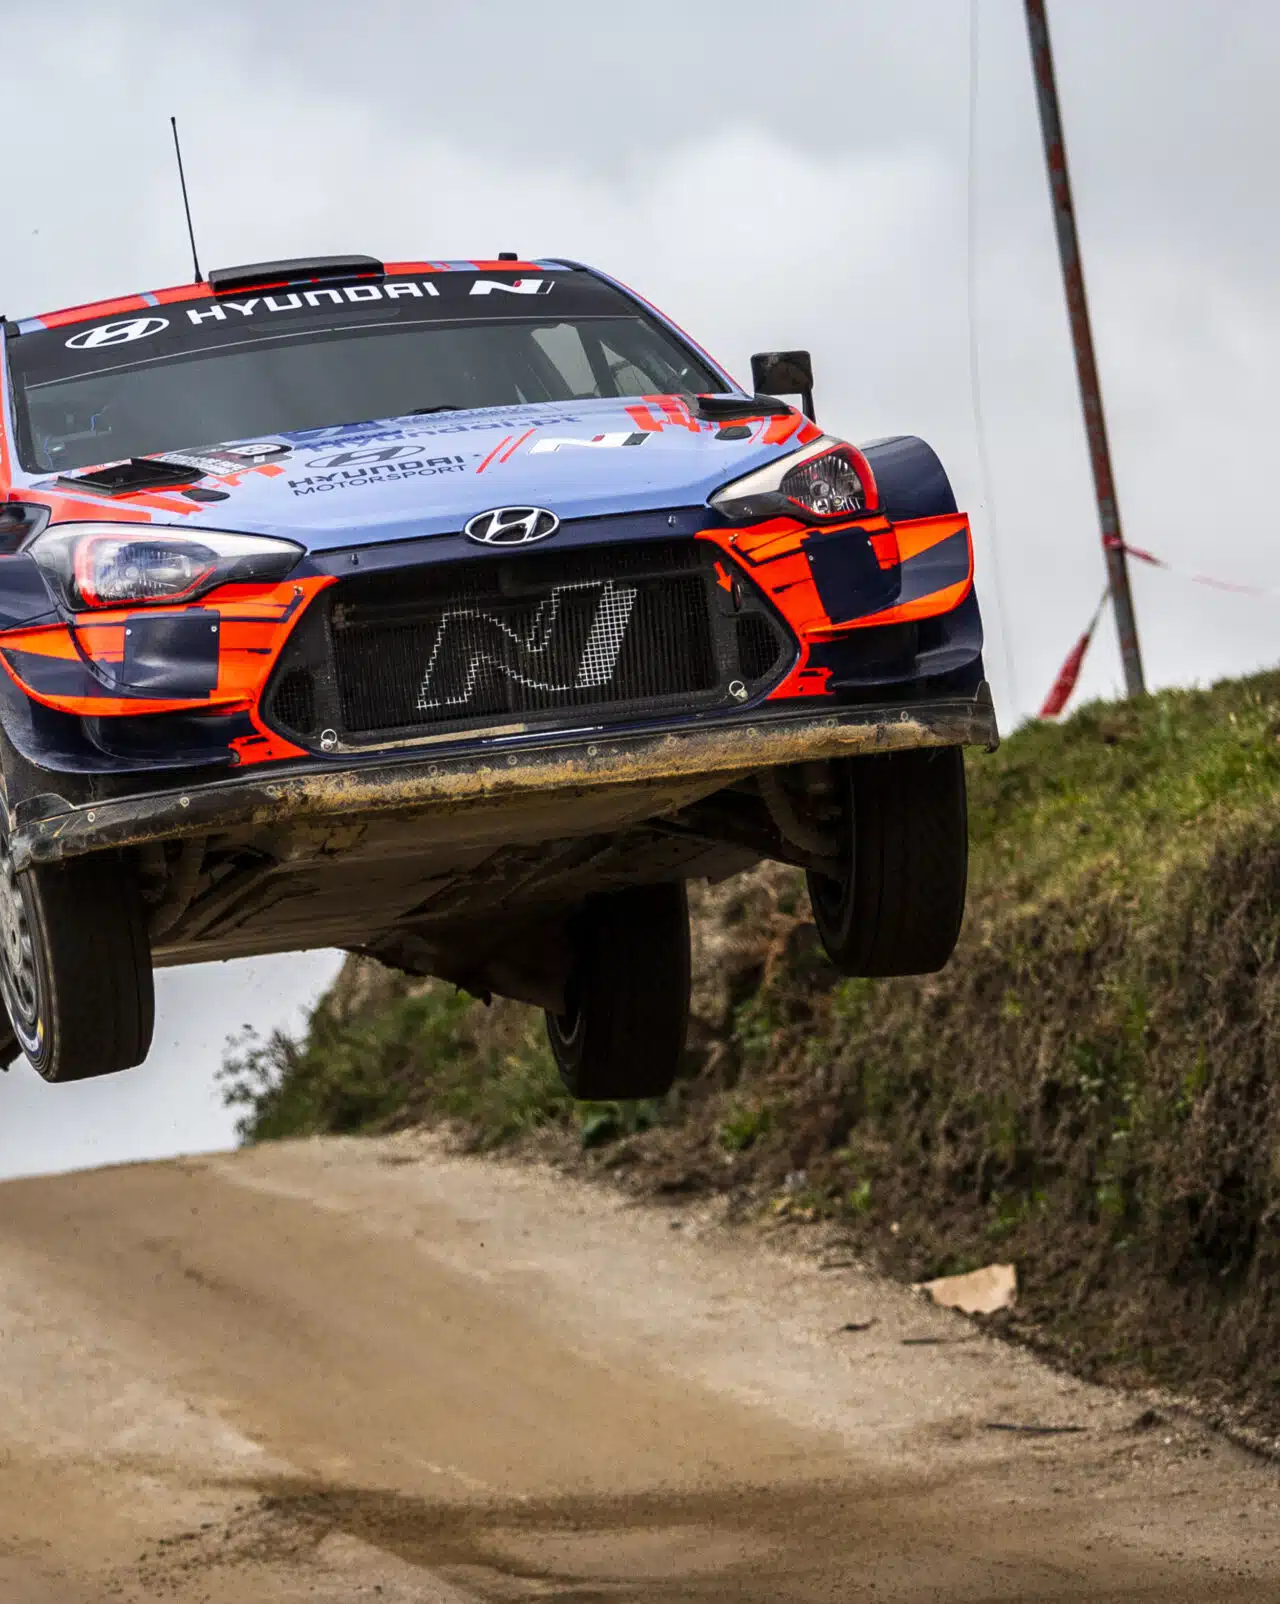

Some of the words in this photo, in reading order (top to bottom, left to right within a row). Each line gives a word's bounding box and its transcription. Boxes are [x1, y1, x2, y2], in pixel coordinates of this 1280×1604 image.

[187, 281, 440, 325] HYUNDAI
[287, 455, 466, 488] HYUNDAI
[293, 464, 469, 497] MOTORSPORT
